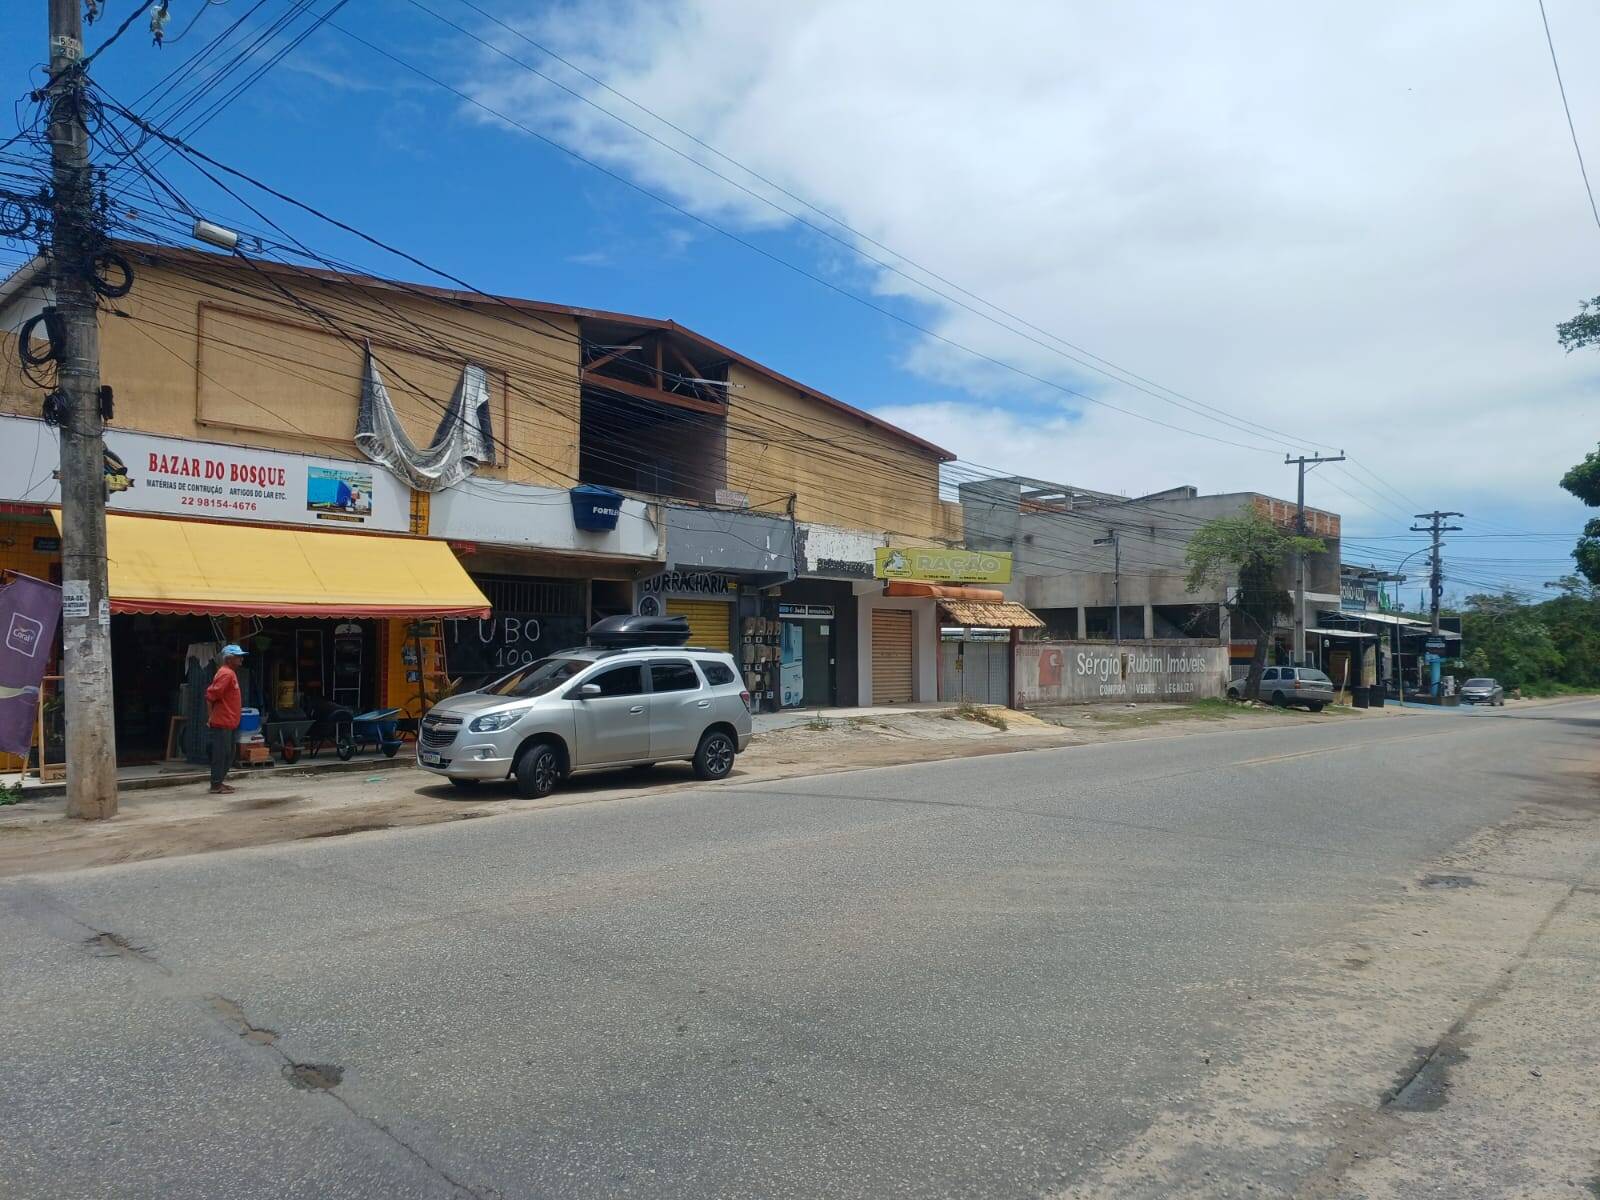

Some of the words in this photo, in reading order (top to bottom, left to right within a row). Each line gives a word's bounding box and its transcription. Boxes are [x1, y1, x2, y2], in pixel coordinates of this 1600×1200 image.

[148, 453, 201, 477] BAZAR
[205, 460, 225, 480] DO
[230, 463, 286, 488] BOSQUE
[178, 482, 187, 491] DE
[229, 487, 253, 497] ARTIGOS
[254, 489, 263, 498] DO
[263, 491, 274, 499] LAR
[181, 496, 194, 506] 22
[197, 498, 257, 511] 98154-4676
[917, 553, 1000, 575] RAÇÃO
[444, 617, 540, 643] TUBO
[496, 647, 533, 668] 100
[1077, 652, 1120, 681] Sérgio
[1127, 654, 1162, 673] Rubim
[1167, 652, 1206, 673] Imóveis
[1100, 682, 1126, 695] COMPRA
[1165, 682, 1194, 694] LEGALIZA
